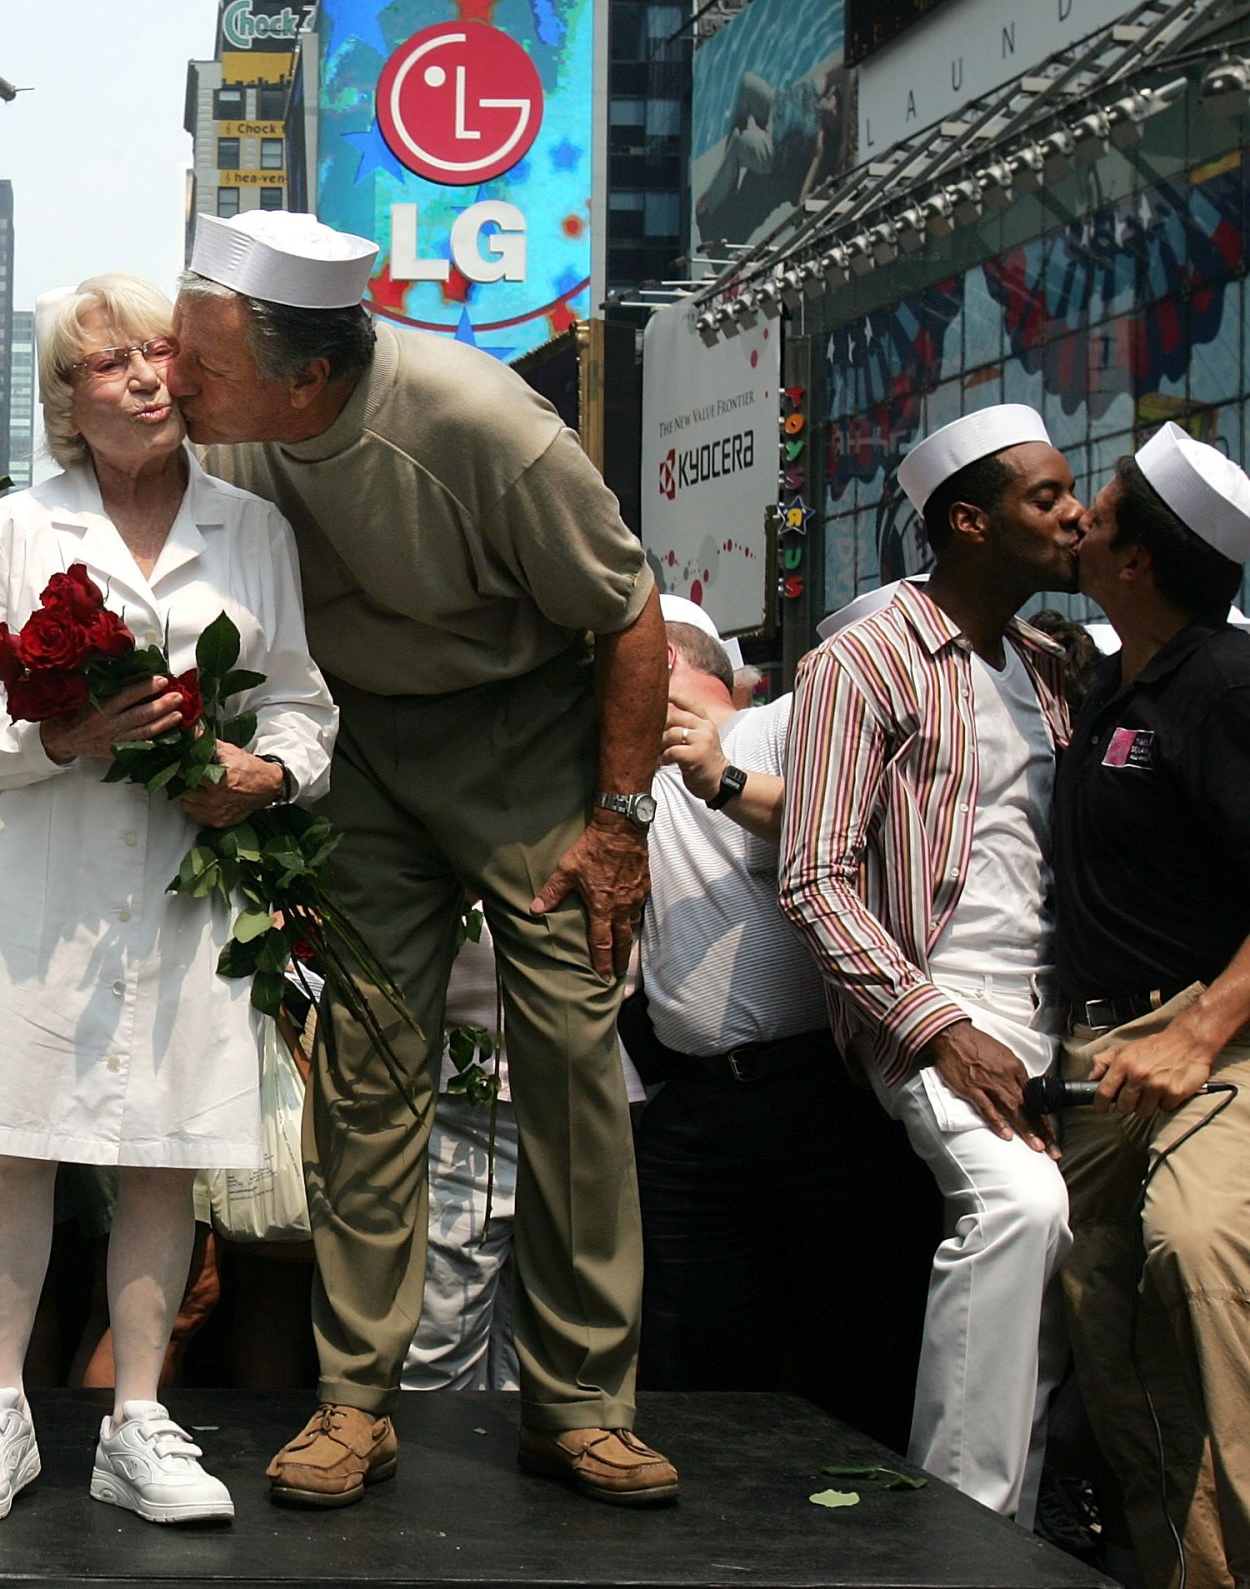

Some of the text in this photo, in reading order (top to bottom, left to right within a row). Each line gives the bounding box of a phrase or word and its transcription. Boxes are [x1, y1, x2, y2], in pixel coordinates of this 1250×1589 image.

[222, 0, 300, 49] Chock
[237, 122, 277, 135] Chock
[389, 199, 527, 283] LG
[659, 389, 755, 438] THE NEW VALUE FRONTIER
[678, 429, 754, 489] KYOCERA
